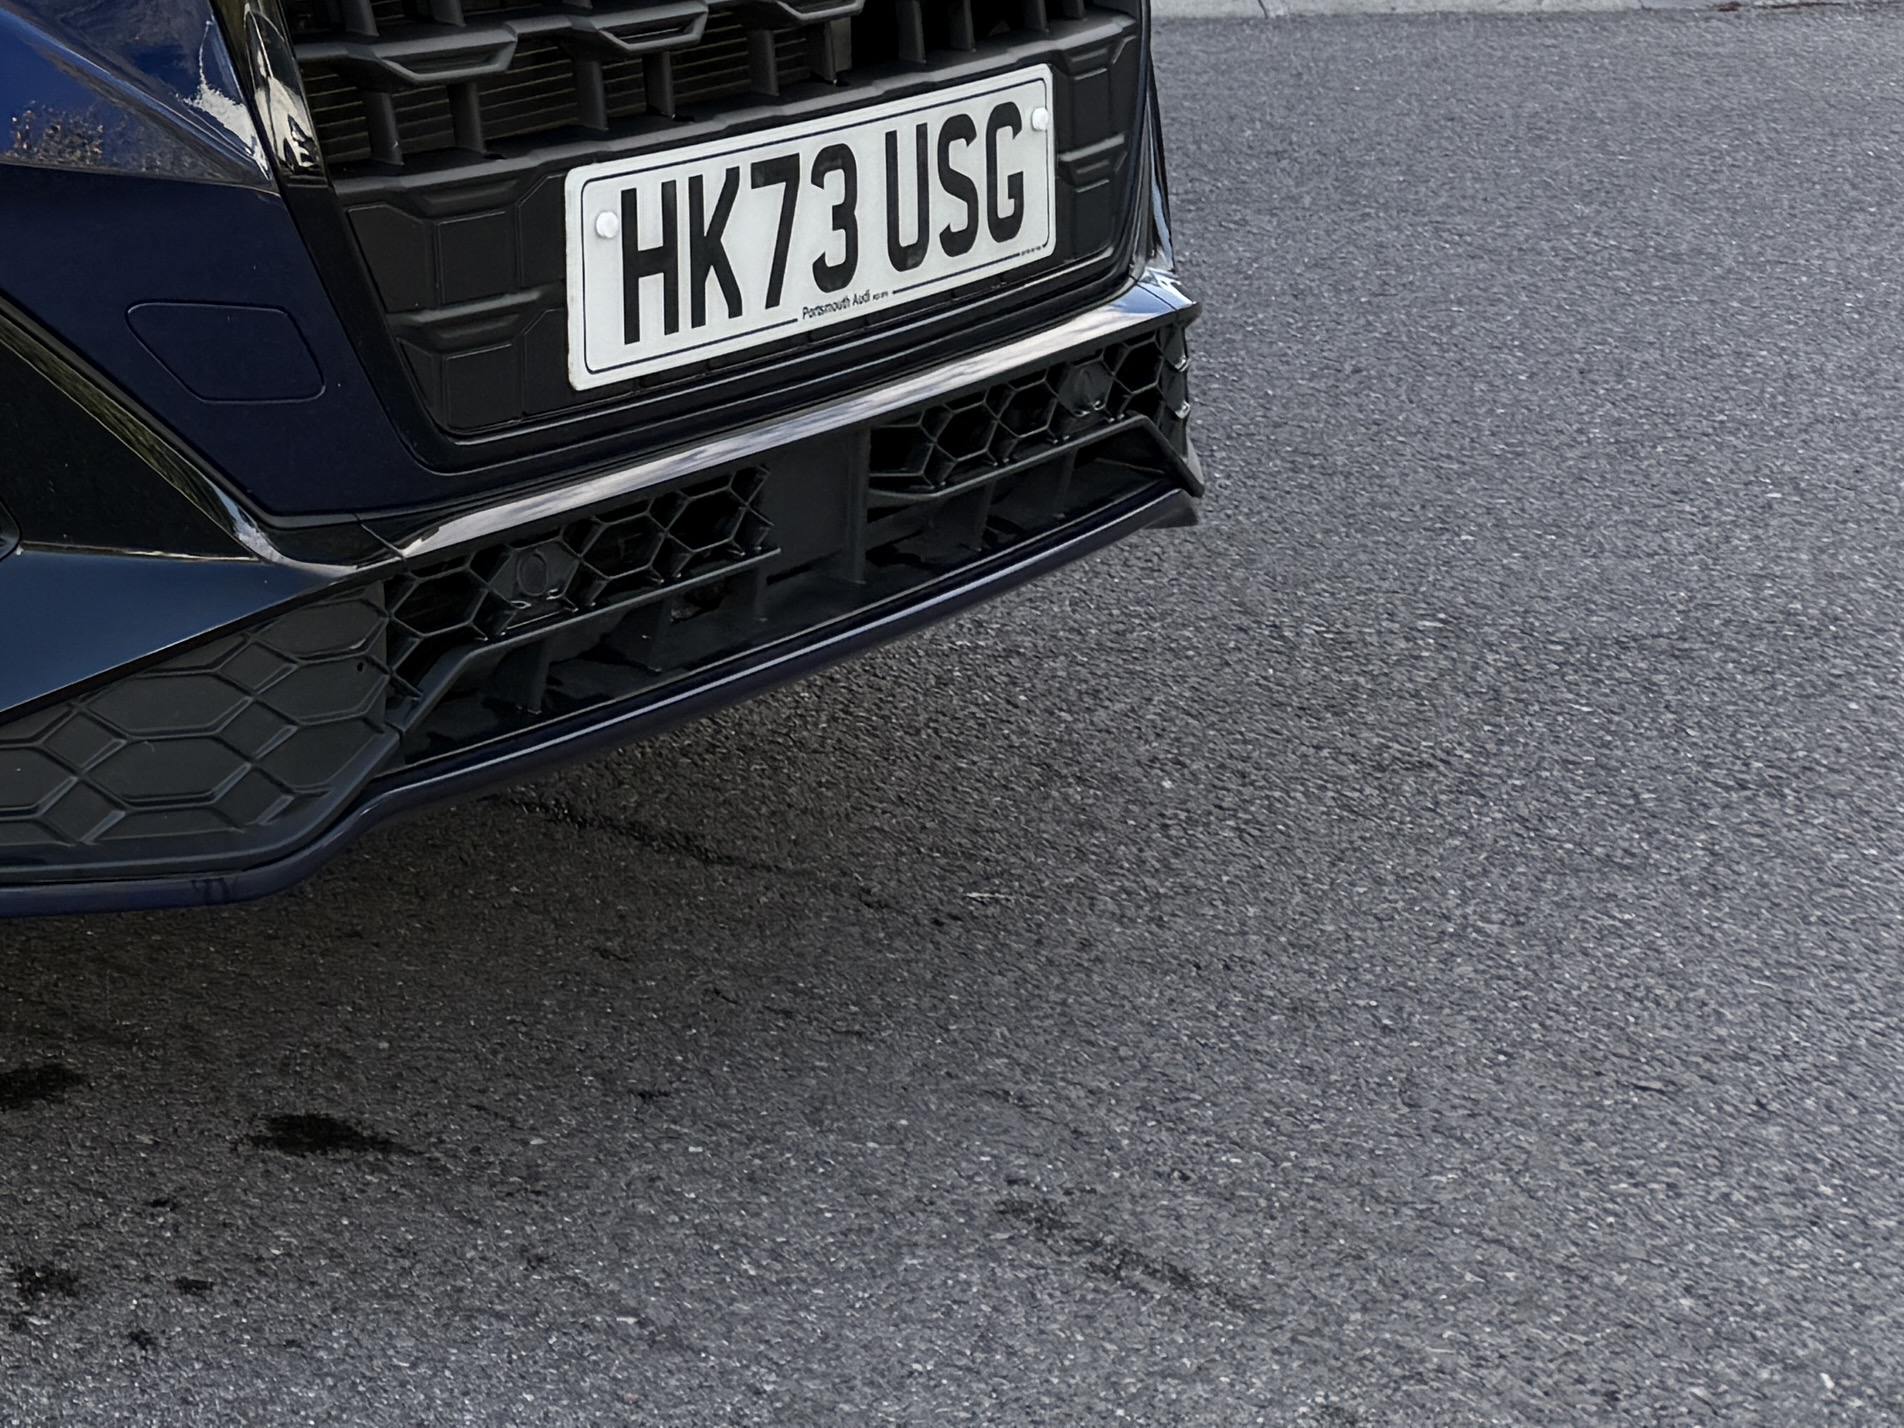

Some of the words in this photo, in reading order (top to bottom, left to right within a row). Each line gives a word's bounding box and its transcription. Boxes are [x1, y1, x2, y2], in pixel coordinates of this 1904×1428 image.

[620, 142, 859, 345] HK73
[884, 100, 1025, 273] USG
[801, 296, 851, 321] Portsmouth
[852, 288, 871, 306] Audi
